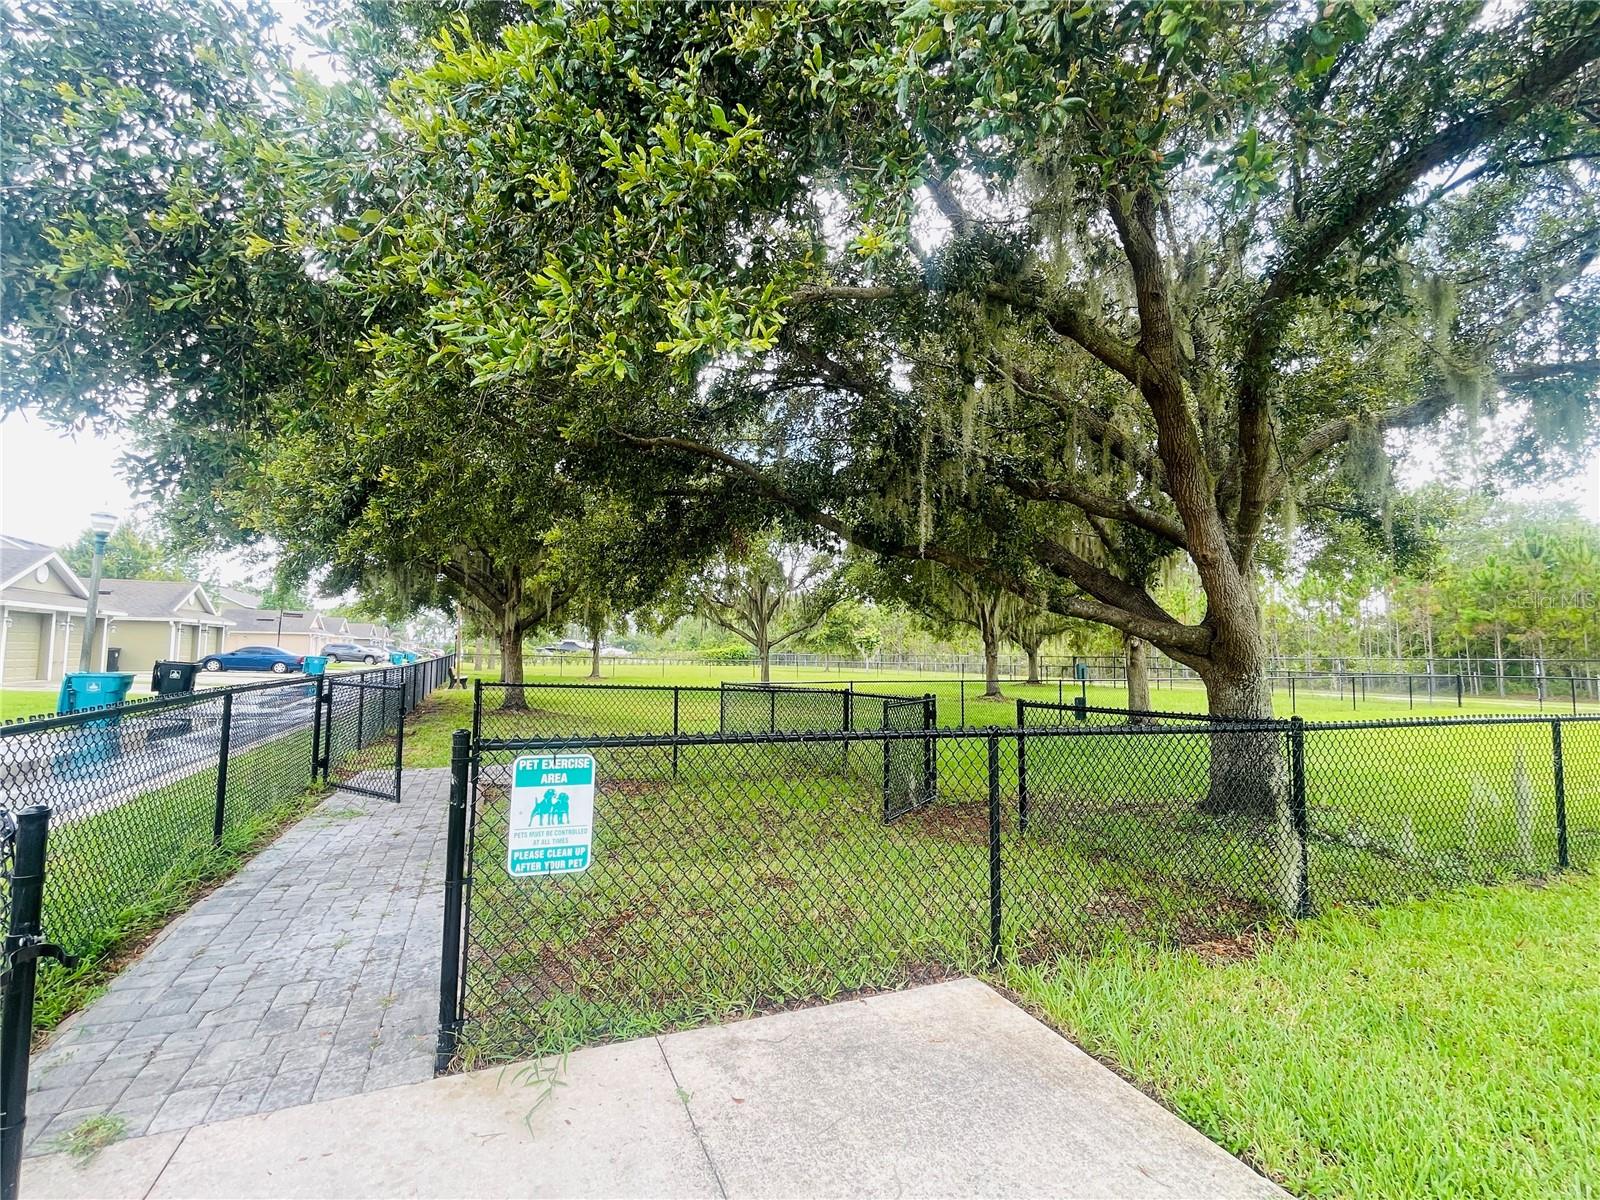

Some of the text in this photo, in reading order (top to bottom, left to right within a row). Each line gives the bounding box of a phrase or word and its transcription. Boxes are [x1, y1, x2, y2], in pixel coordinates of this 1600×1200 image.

[519, 758, 590, 770] PET EXERCISE
[541, 773, 568, 784] AREA
[513, 828, 588, 839] PETS MUST BE CONTROLLED
[513, 847, 586, 860] PLEASE CLEAN UP
[514, 858, 584, 873] AFTER YOUR PET
